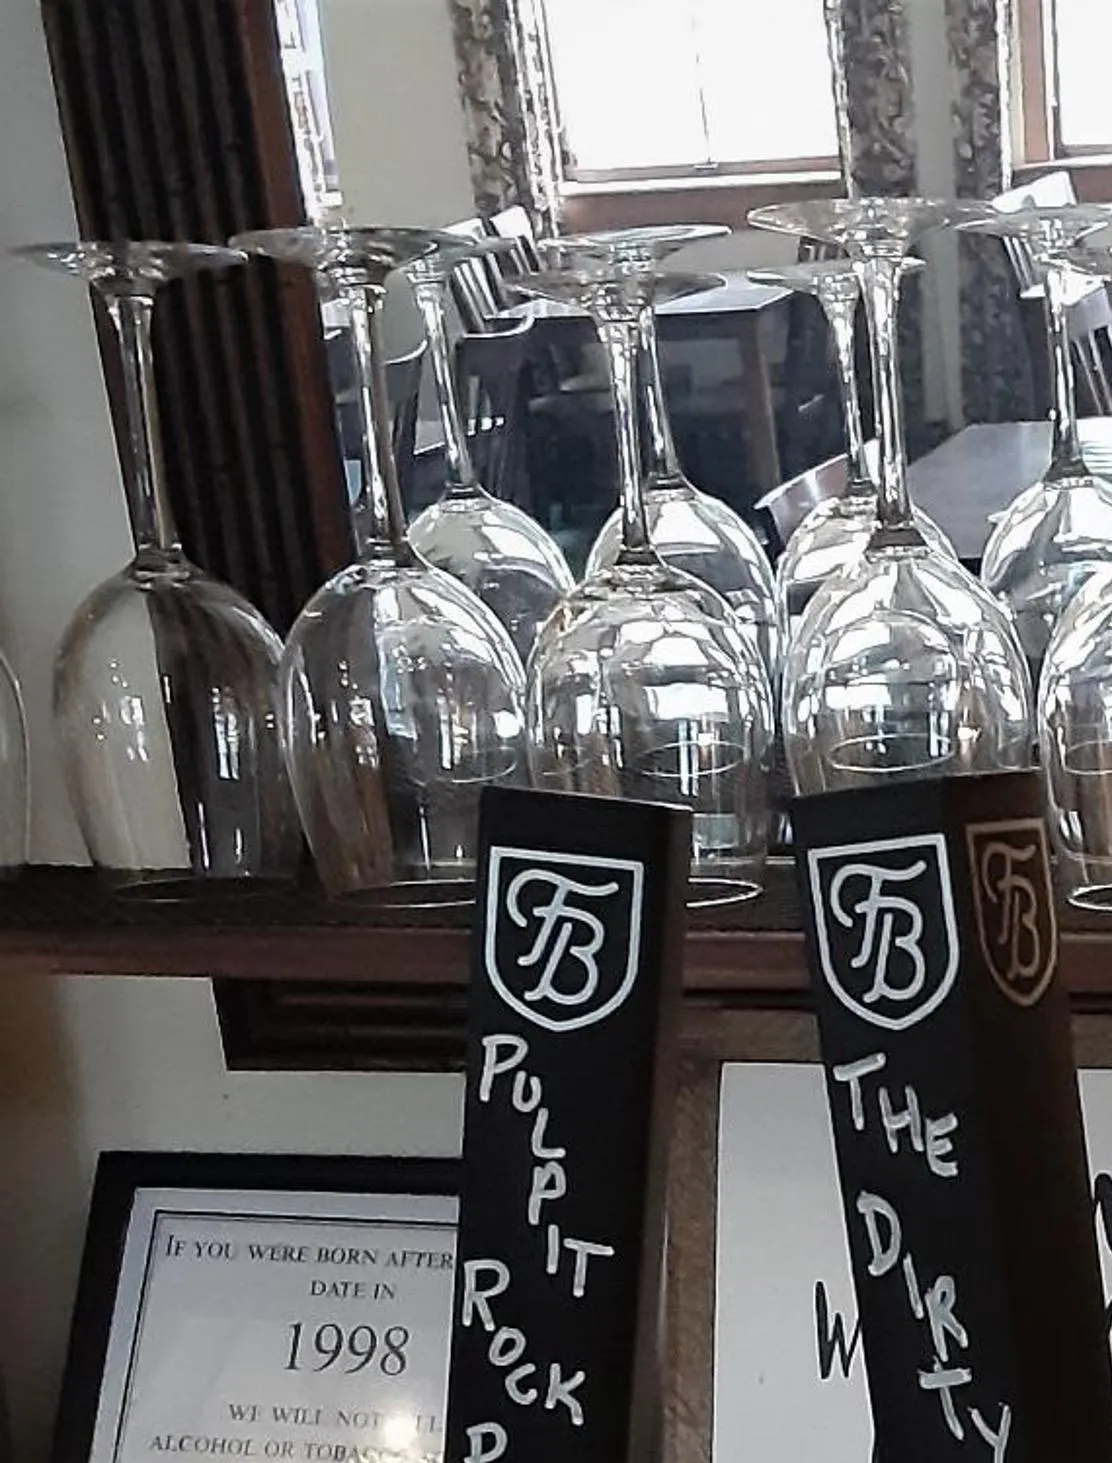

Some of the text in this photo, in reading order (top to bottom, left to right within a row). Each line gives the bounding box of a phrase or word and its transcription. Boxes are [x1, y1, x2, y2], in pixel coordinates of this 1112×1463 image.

[833, 1052, 960, 1178] THE
[479, 1034, 614, 1298] PULPIT
[194, 1242, 235, 1259] YOU
[249, 1243, 307, 1264] WERE
[317, 1247, 377, 1267] BORN
[386, 1251, 454, 1270] AFTER
[310, 1279, 396, 1301] DATE IN
[284, 1320, 411, 1376] 1998
[461, 1258, 587, 1427] ROCK
[151, 1435, 255, 1457] ALCOHOL
[265, 1438, 295, 1460] OR
